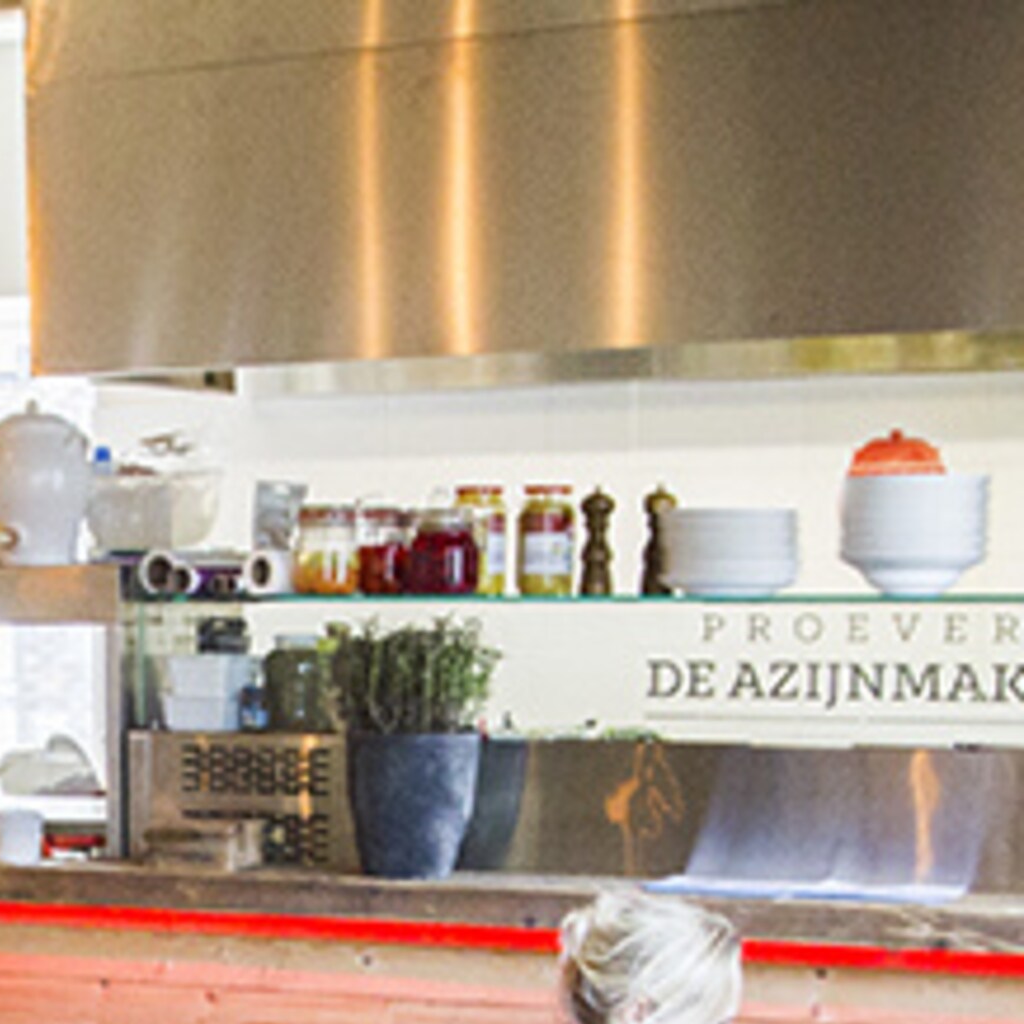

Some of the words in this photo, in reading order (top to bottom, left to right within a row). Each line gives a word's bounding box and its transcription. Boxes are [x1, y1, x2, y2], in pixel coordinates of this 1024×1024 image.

[702, 612, 1021, 644] PROEVER
[645, 658, 716, 700] DE
[728, 660, 1024, 710] AZIJNMAK
